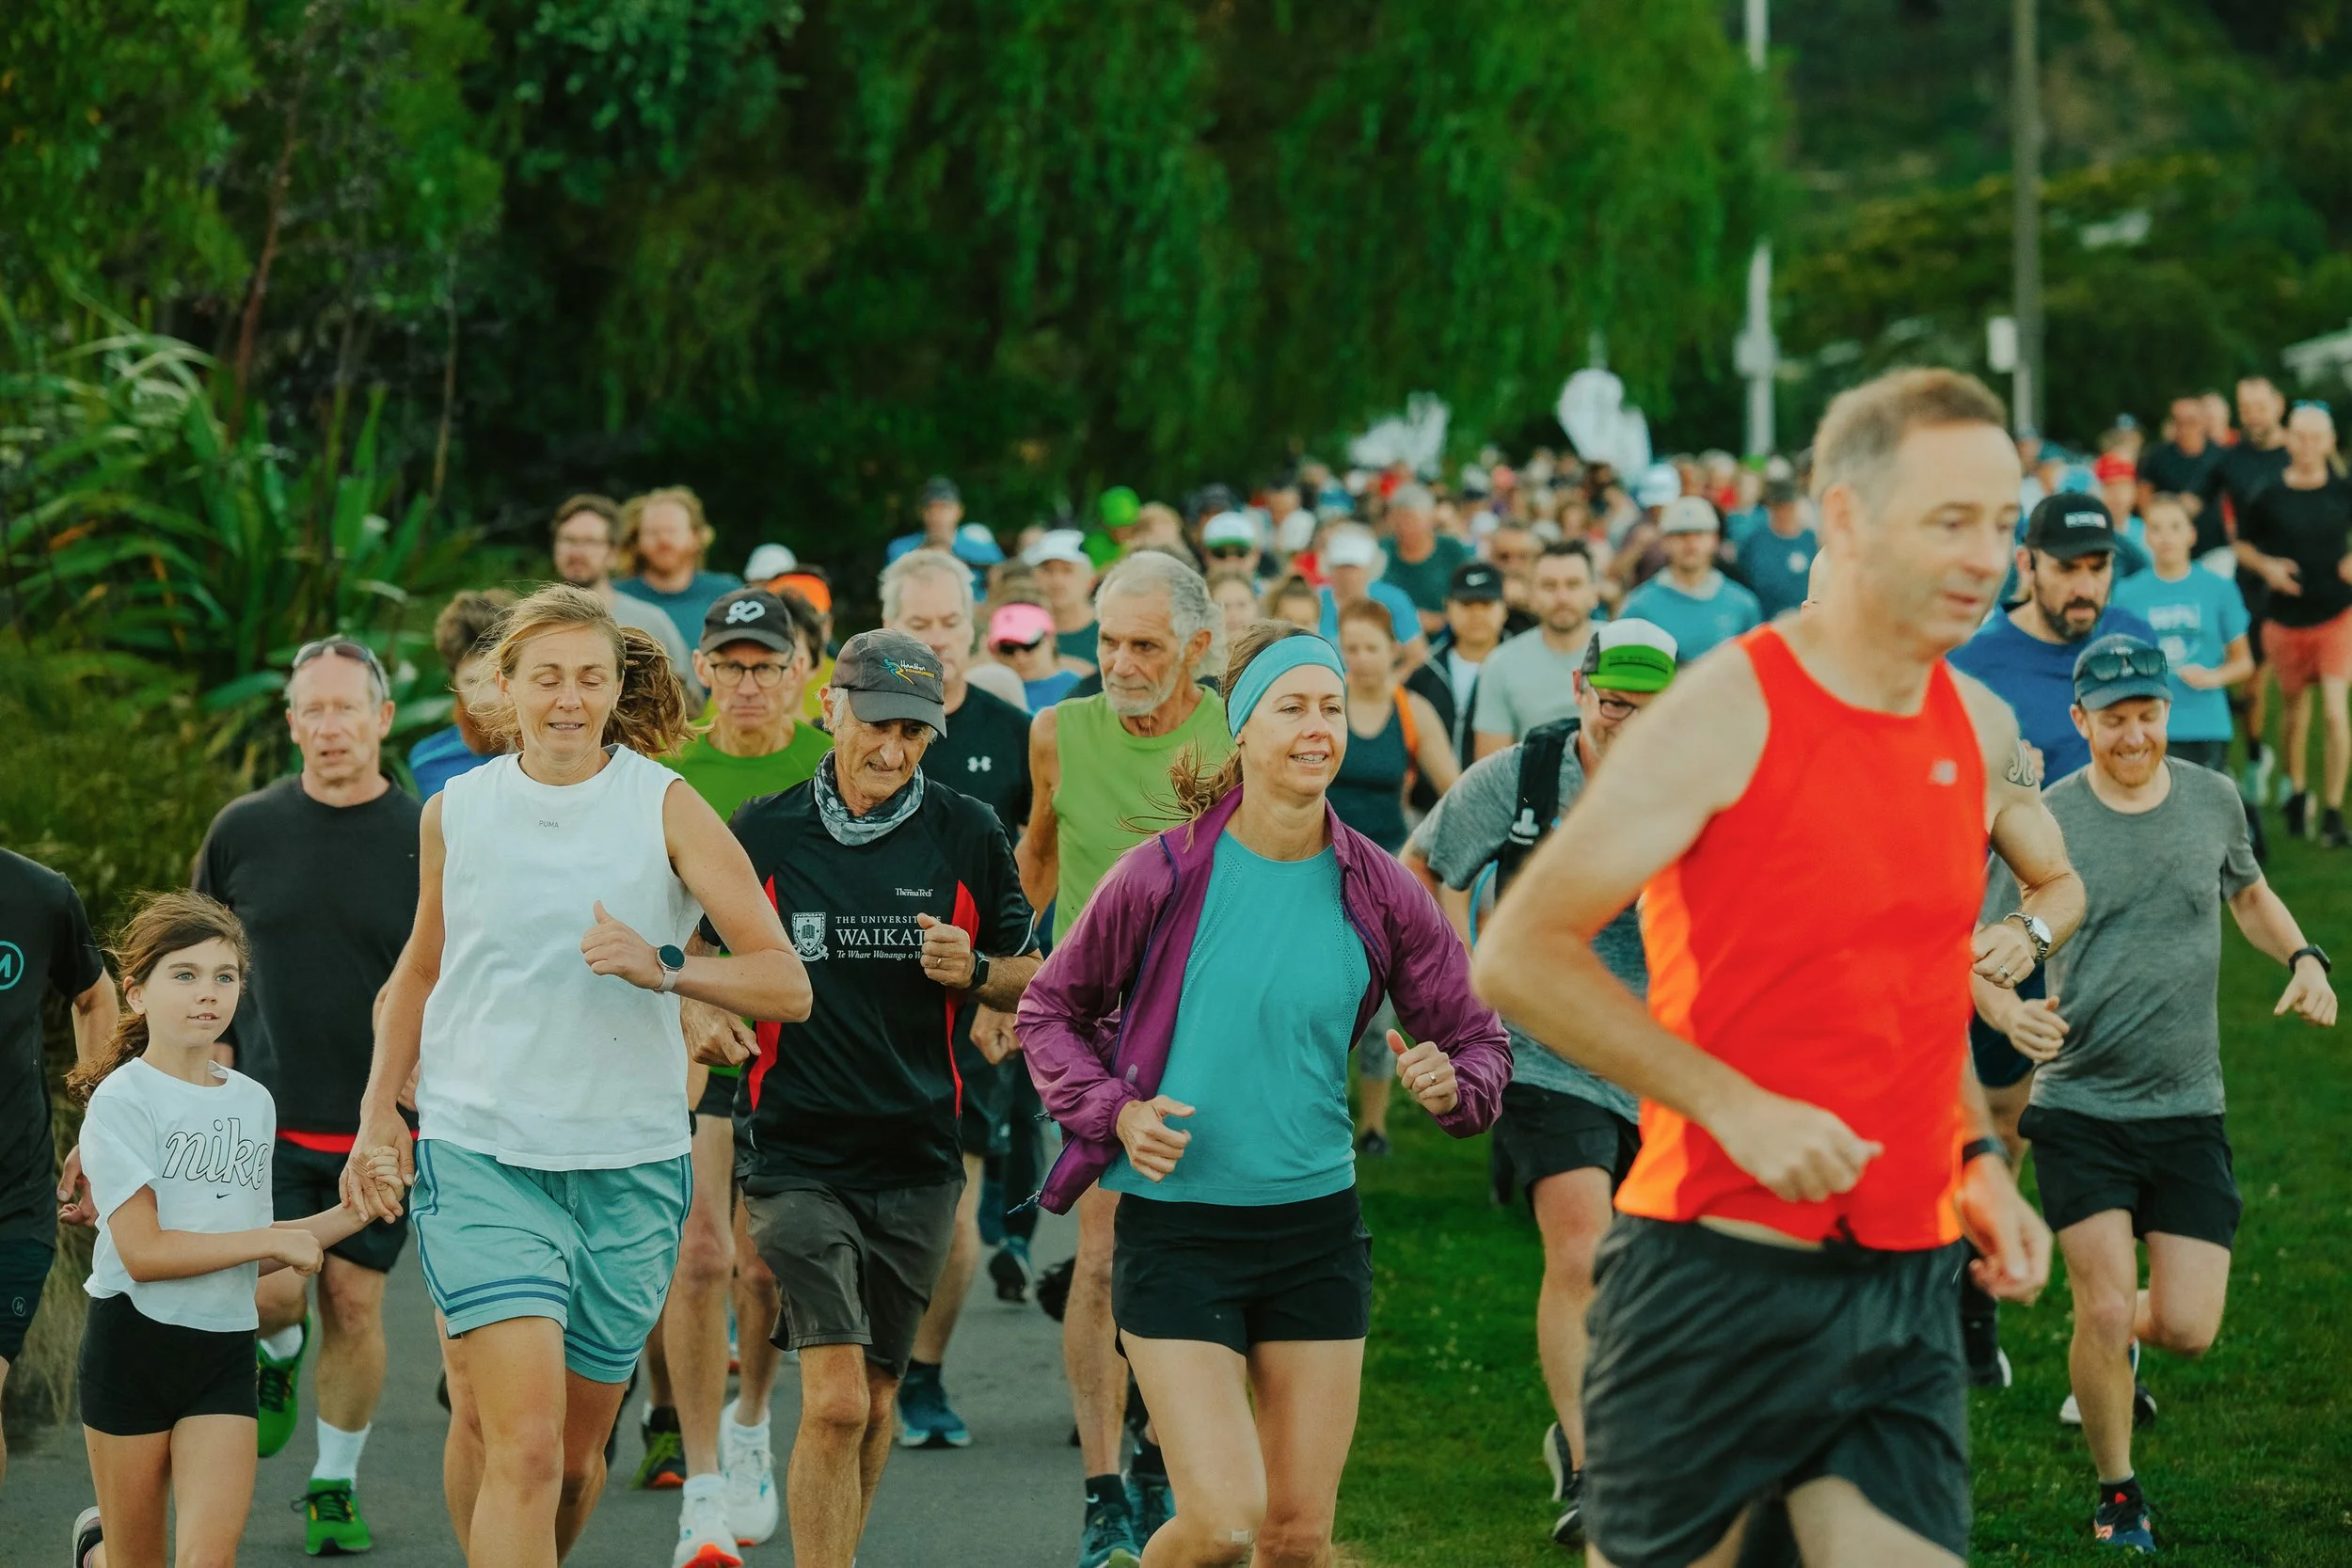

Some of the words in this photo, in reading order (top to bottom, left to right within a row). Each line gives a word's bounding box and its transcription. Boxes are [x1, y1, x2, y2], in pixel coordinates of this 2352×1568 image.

[539, 819, 559, 828] PUMA
[835, 928, 927, 946] WAIKAT
[836, 950, 846, 958] Te
[848, 950, 871, 958] Whare
[162, 1117, 269, 1191] nike
